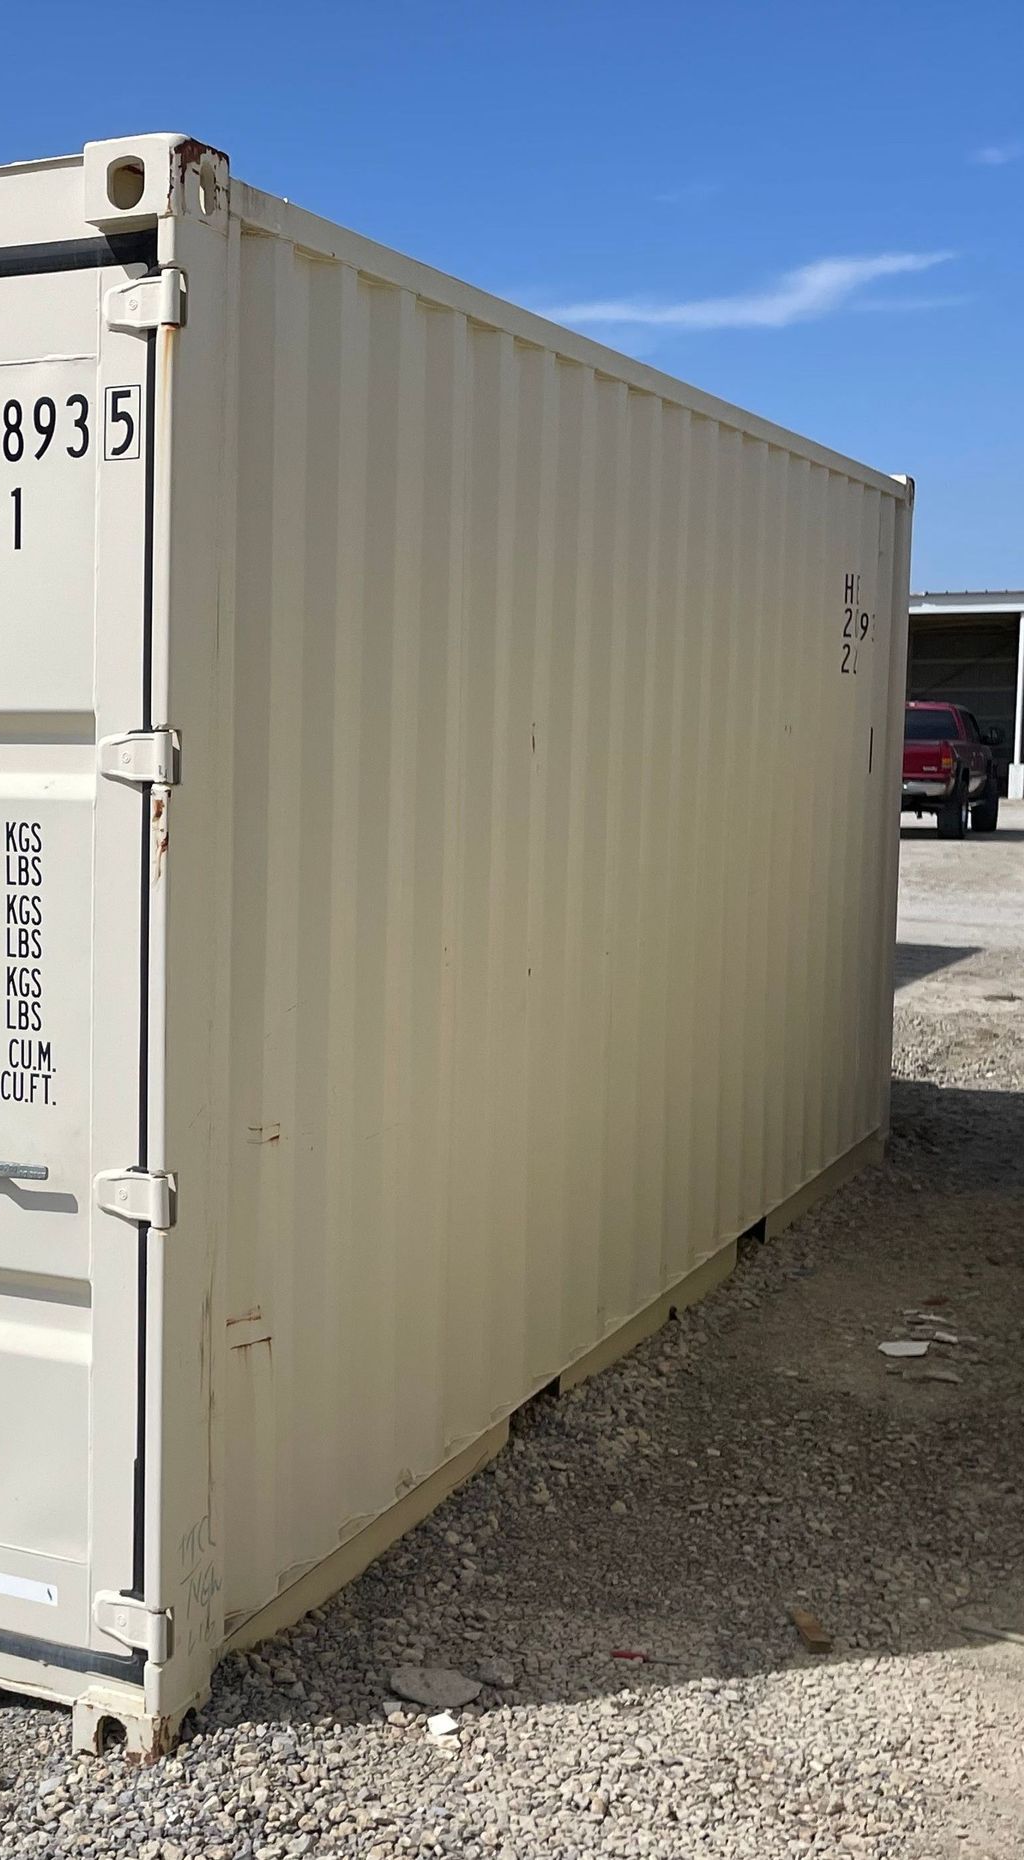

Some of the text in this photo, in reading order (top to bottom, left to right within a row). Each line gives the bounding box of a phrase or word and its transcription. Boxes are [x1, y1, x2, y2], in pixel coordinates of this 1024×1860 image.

[110, 390, 134, 456] 5
[844, 573, 861, 605] H
[6, 822, 41, 852] KGS
[7, 855, 41, 886] LBS
[7, 895, 41, 925] KGS
[7, 928, 41, 958] LBS
[7, 967, 41, 997] KGS
[7, 1000, 41, 1031] LBS
